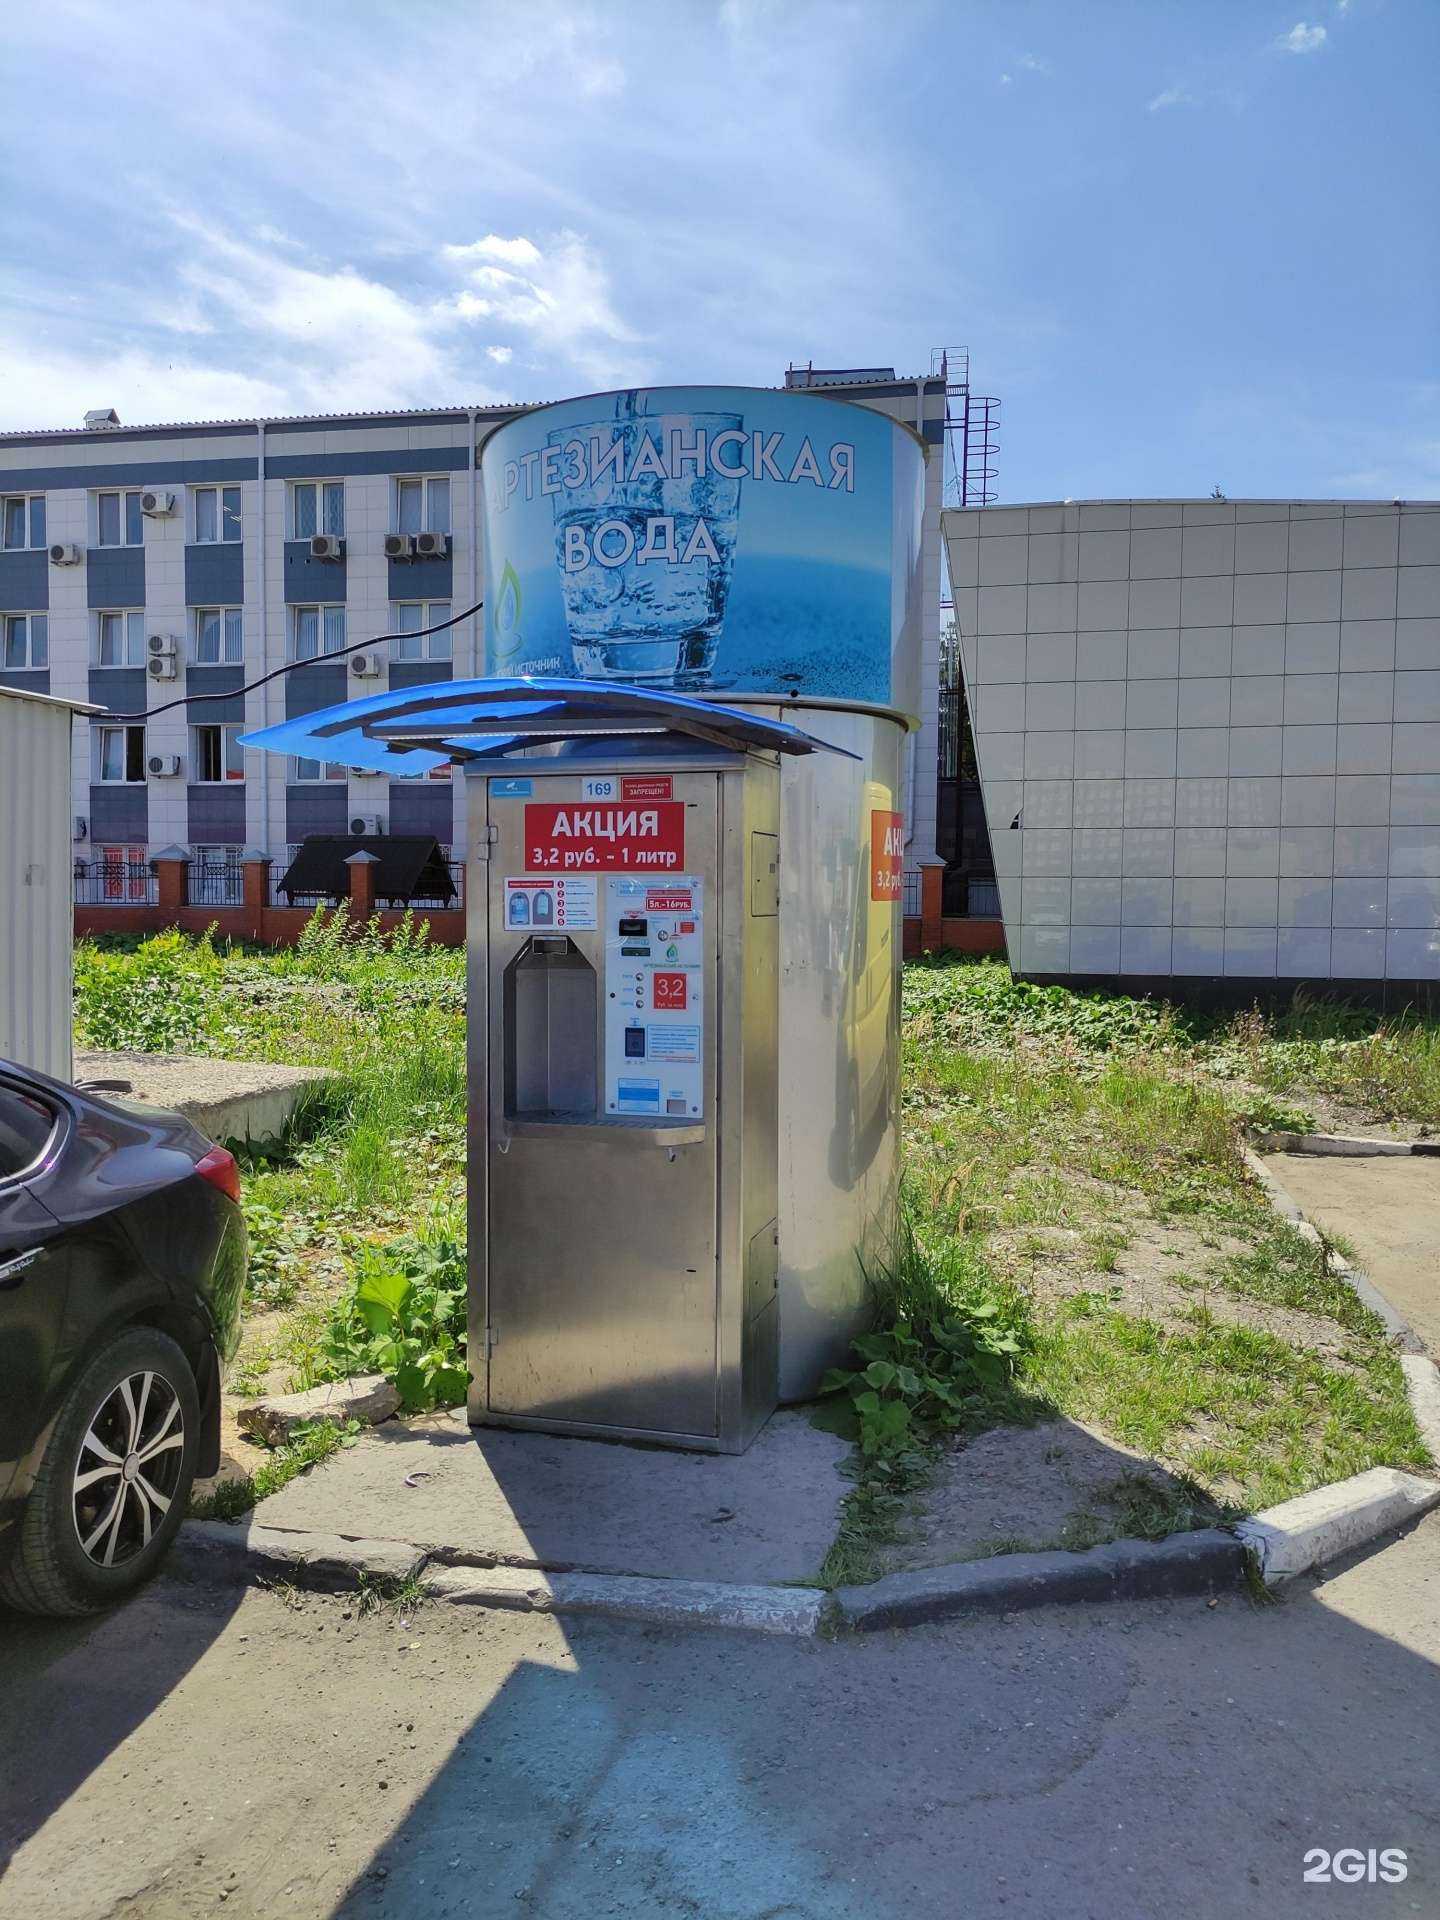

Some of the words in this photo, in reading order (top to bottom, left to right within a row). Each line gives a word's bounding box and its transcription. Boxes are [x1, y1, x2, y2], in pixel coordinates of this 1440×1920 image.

[564, 515, 721, 573] ВОДА
[586, 783, 612, 796] 169
[551, 810, 659, 843] АКЦИЯ
[532, 847, 560, 867] 3,2
[565, 847, 600, 868] руб.
[621, 848, 629, 863] 1
[635, 850, 677, 868] литр
[877, 870, 890, 890] 3,2
[657, 978, 684, 999] 3,2
